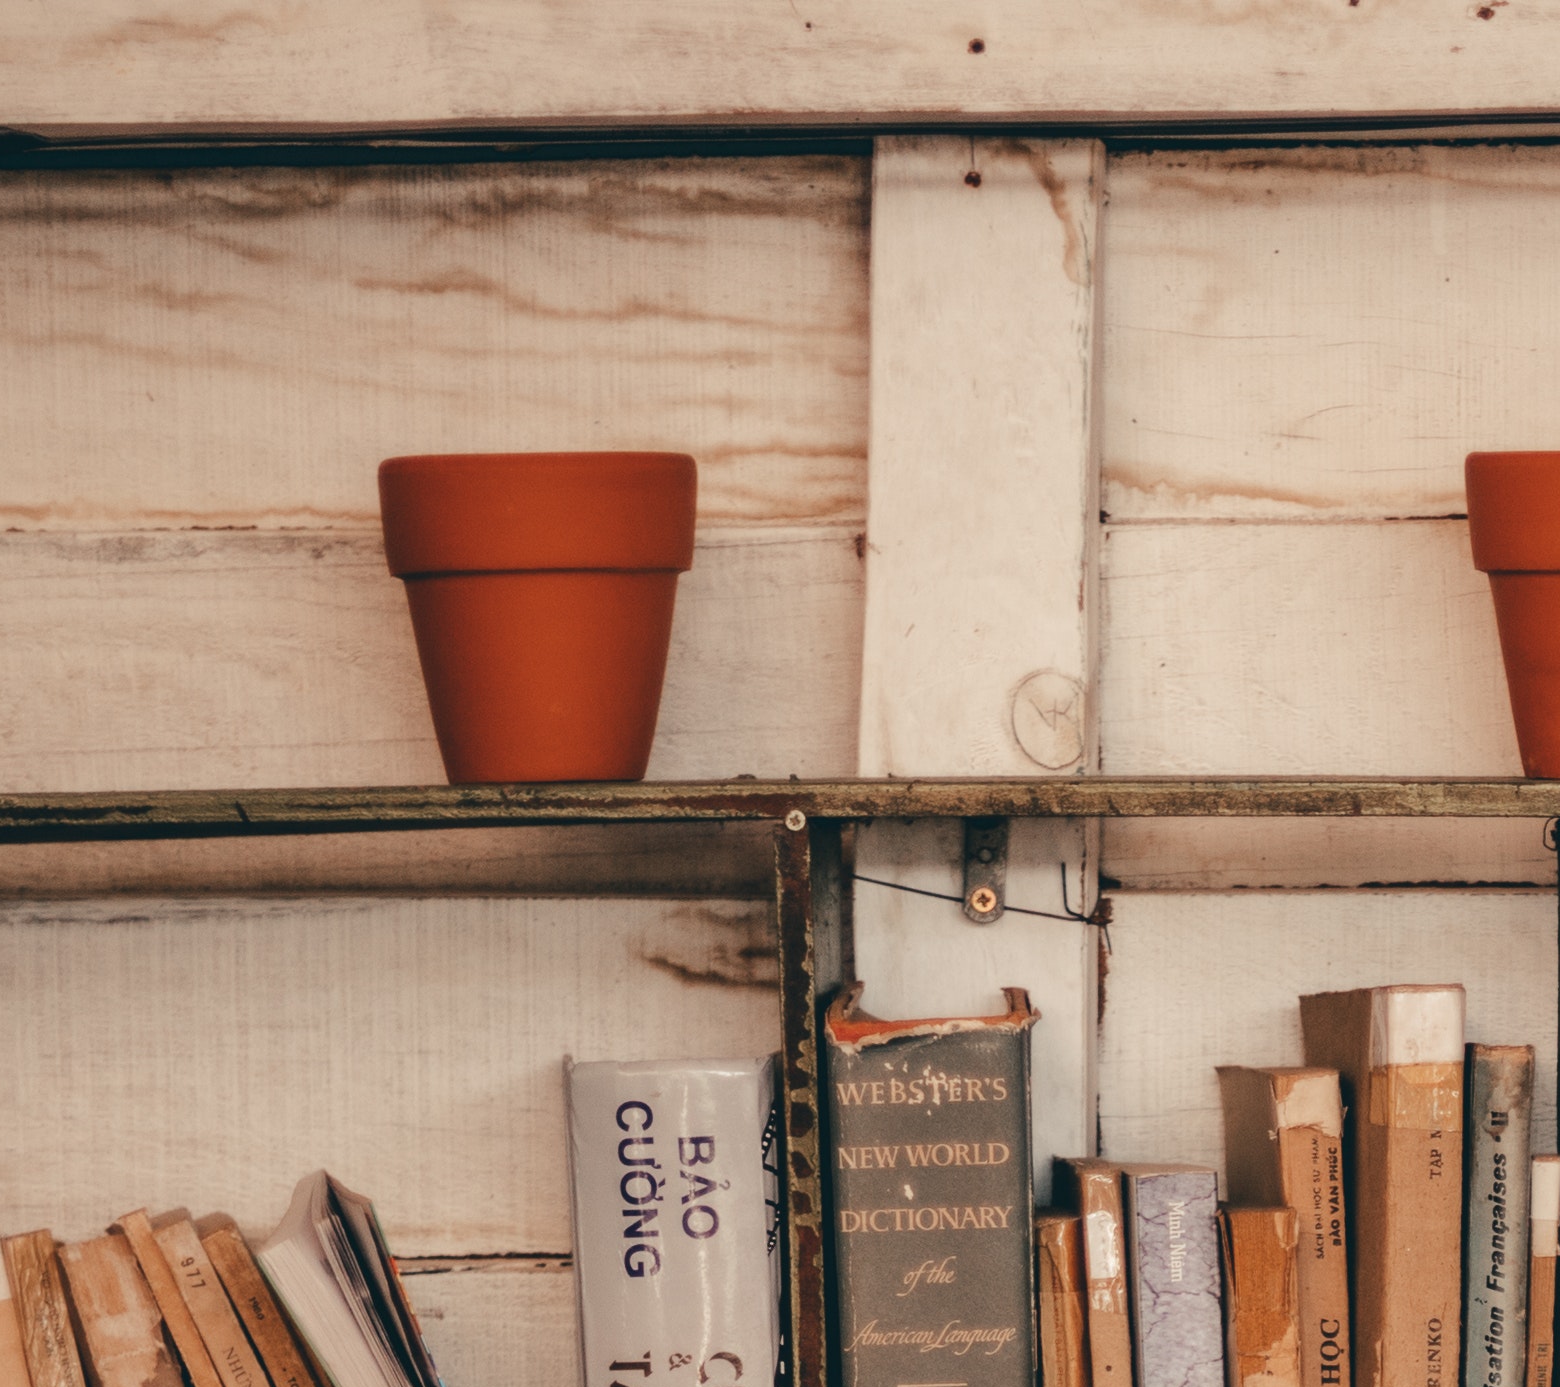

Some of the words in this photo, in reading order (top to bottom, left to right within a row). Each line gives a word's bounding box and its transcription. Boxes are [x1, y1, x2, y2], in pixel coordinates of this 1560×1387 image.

[837, 1077, 1008, 1106] WEBSTER'S
[838, 1145, 900, 1169] NEW
[905, 1142, 1010, 1168] WORLD
[613, 1098, 670, 1278] CƯỜNG
[676, 1134, 732, 1241] BẢO
[840, 1206, 1013, 1233] DICTIONARY
[1168, 1201, 1186, 1239] Minh
[1484, 1152, 1512, 1292] Françaises
[896, 1259, 928, 1297] of
[926, 1255, 957, 1285] the
[844, 1319, 934, 1352] American
[920, 1319, 1017, 1356] Language
[1318, 1316, 1346, 1386] HỌC
